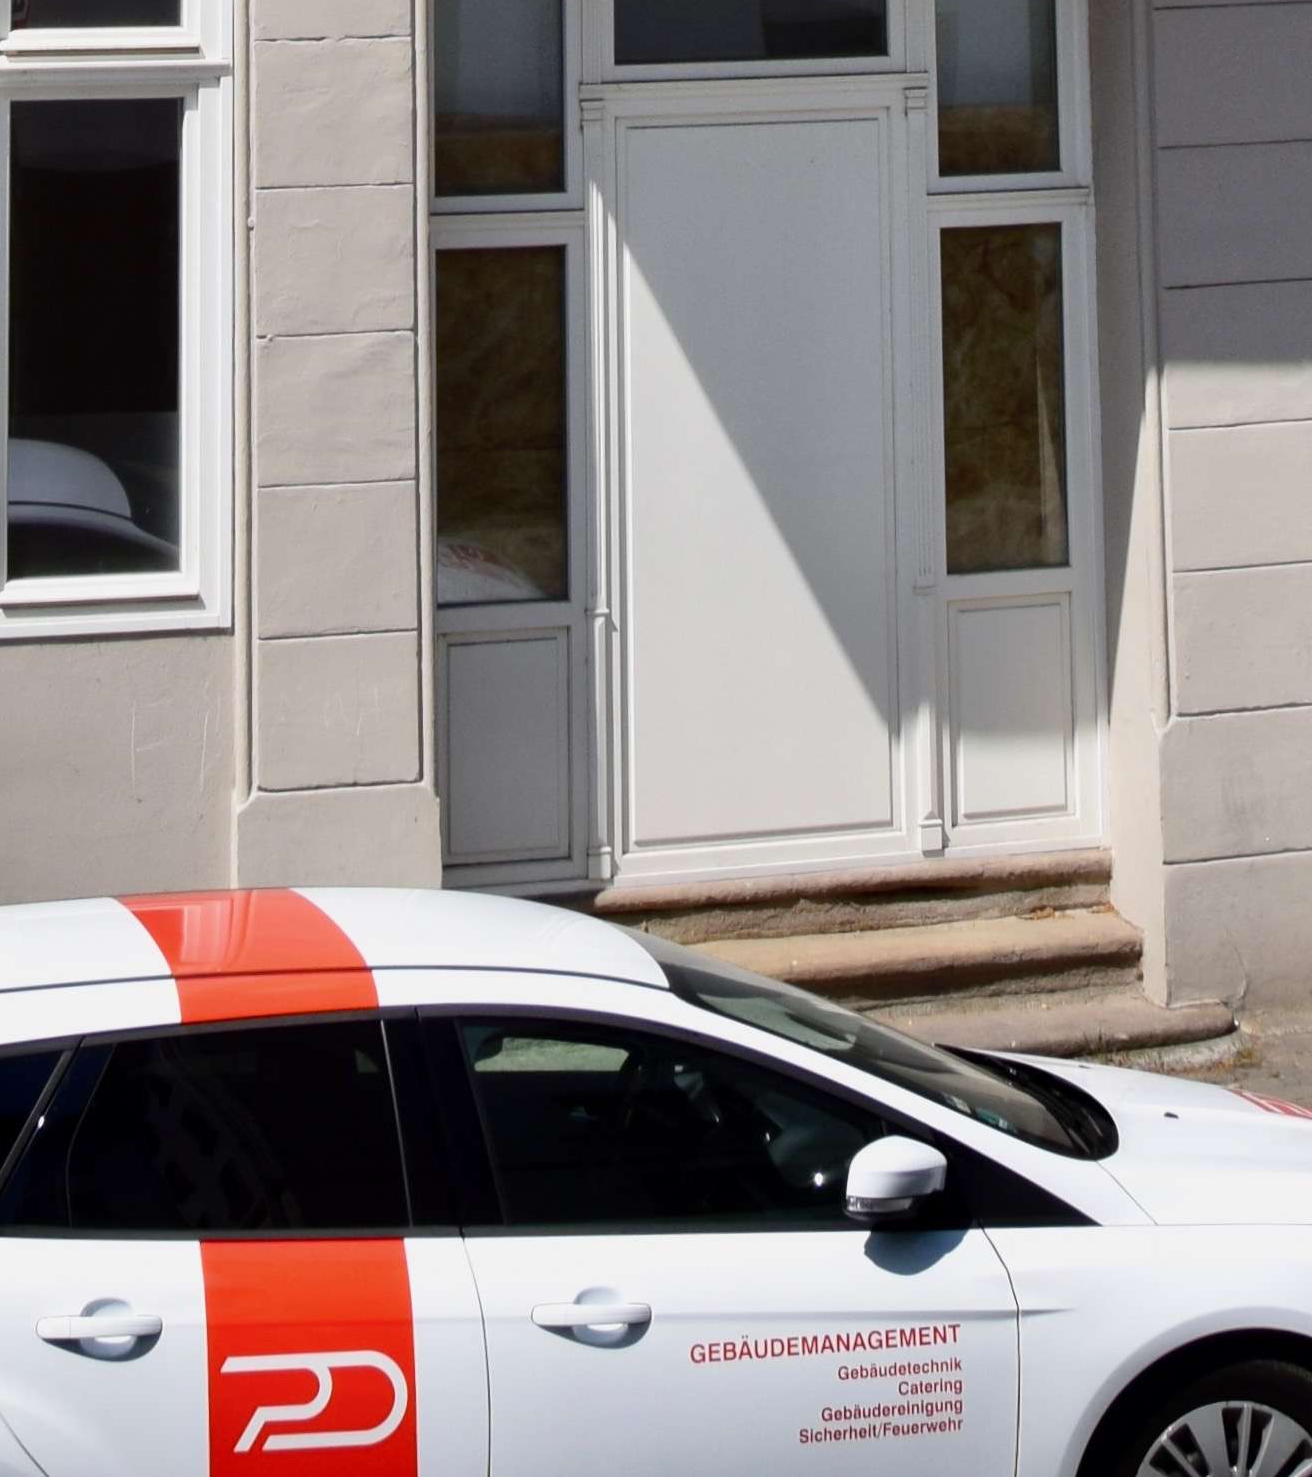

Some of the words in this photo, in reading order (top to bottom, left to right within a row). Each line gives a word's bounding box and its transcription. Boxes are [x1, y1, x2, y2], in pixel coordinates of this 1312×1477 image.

[690, 1324, 961, 1364] GEBÄUDEMANAGEMENT
[837, 1357, 963, 1380] Gebäudetechnik
[898, 1378, 963, 1396] Catering
[821, 1399, 963, 1422] Gebäudereinigung
[799, 1417, 963, 1444] Sicherheit/Feuerwehr
